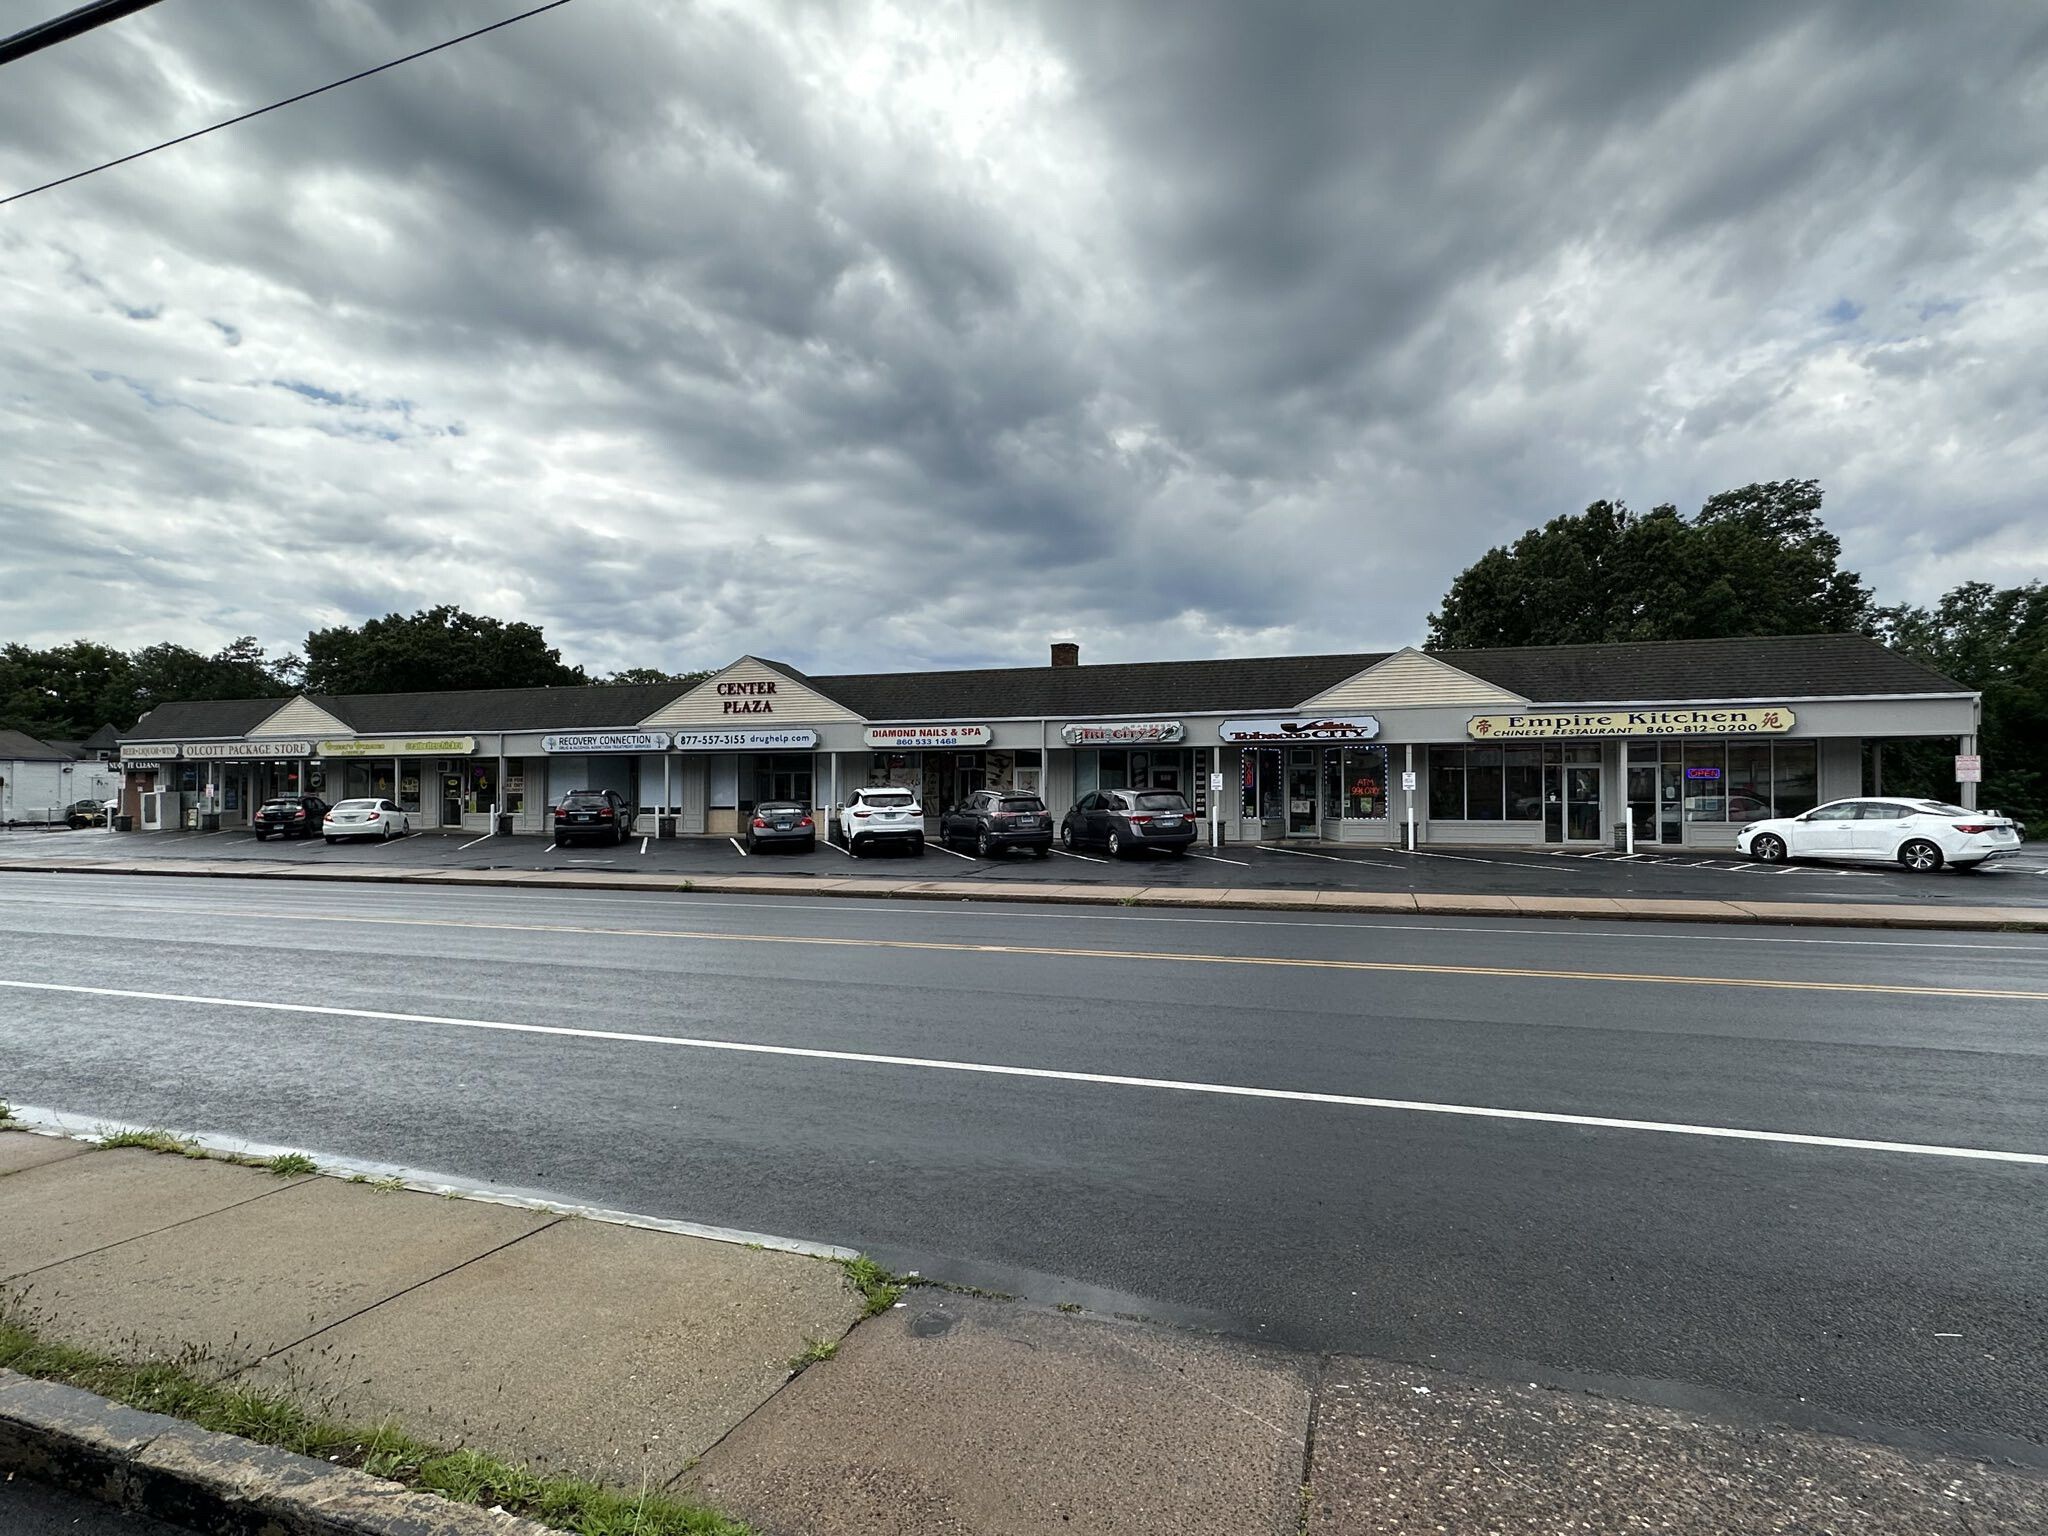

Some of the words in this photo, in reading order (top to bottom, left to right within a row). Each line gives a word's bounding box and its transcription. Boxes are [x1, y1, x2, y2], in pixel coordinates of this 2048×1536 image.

[717, 682, 777, 696] CENTER
[723, 700, 773, 713] PLAZA
[1508, 715, 1612, 729] Empire
[1628, 711, 1748, 724] Kitchen
[872, 729, 917, 738] DIAMOND
[919, 728, 948, 737] NAILS
[950, 728, 958, 736] &
[961, 727, 981, 736] SPA
[1493, 729, 1546, 737] CHINESE
[1552, 727, 1633, 736] RESTAURANT
[1646, 723, 1758, 734] 860-812-0200
[558, 736, 597, 746] RECOVERY
[599, 735, 651, 745] CONNECTION
[680, 735, 746, 745] 877-557-3155
[896, 738, 913, 746] 860
[915, 738, 932, 746] 533
[186, 745, 224, 756] OLCOTT
[228, 744, 272, 755] PACKAGE
[274, 743, 306, 754] STORE
[1689, 769, 1718, 777] OPEN
